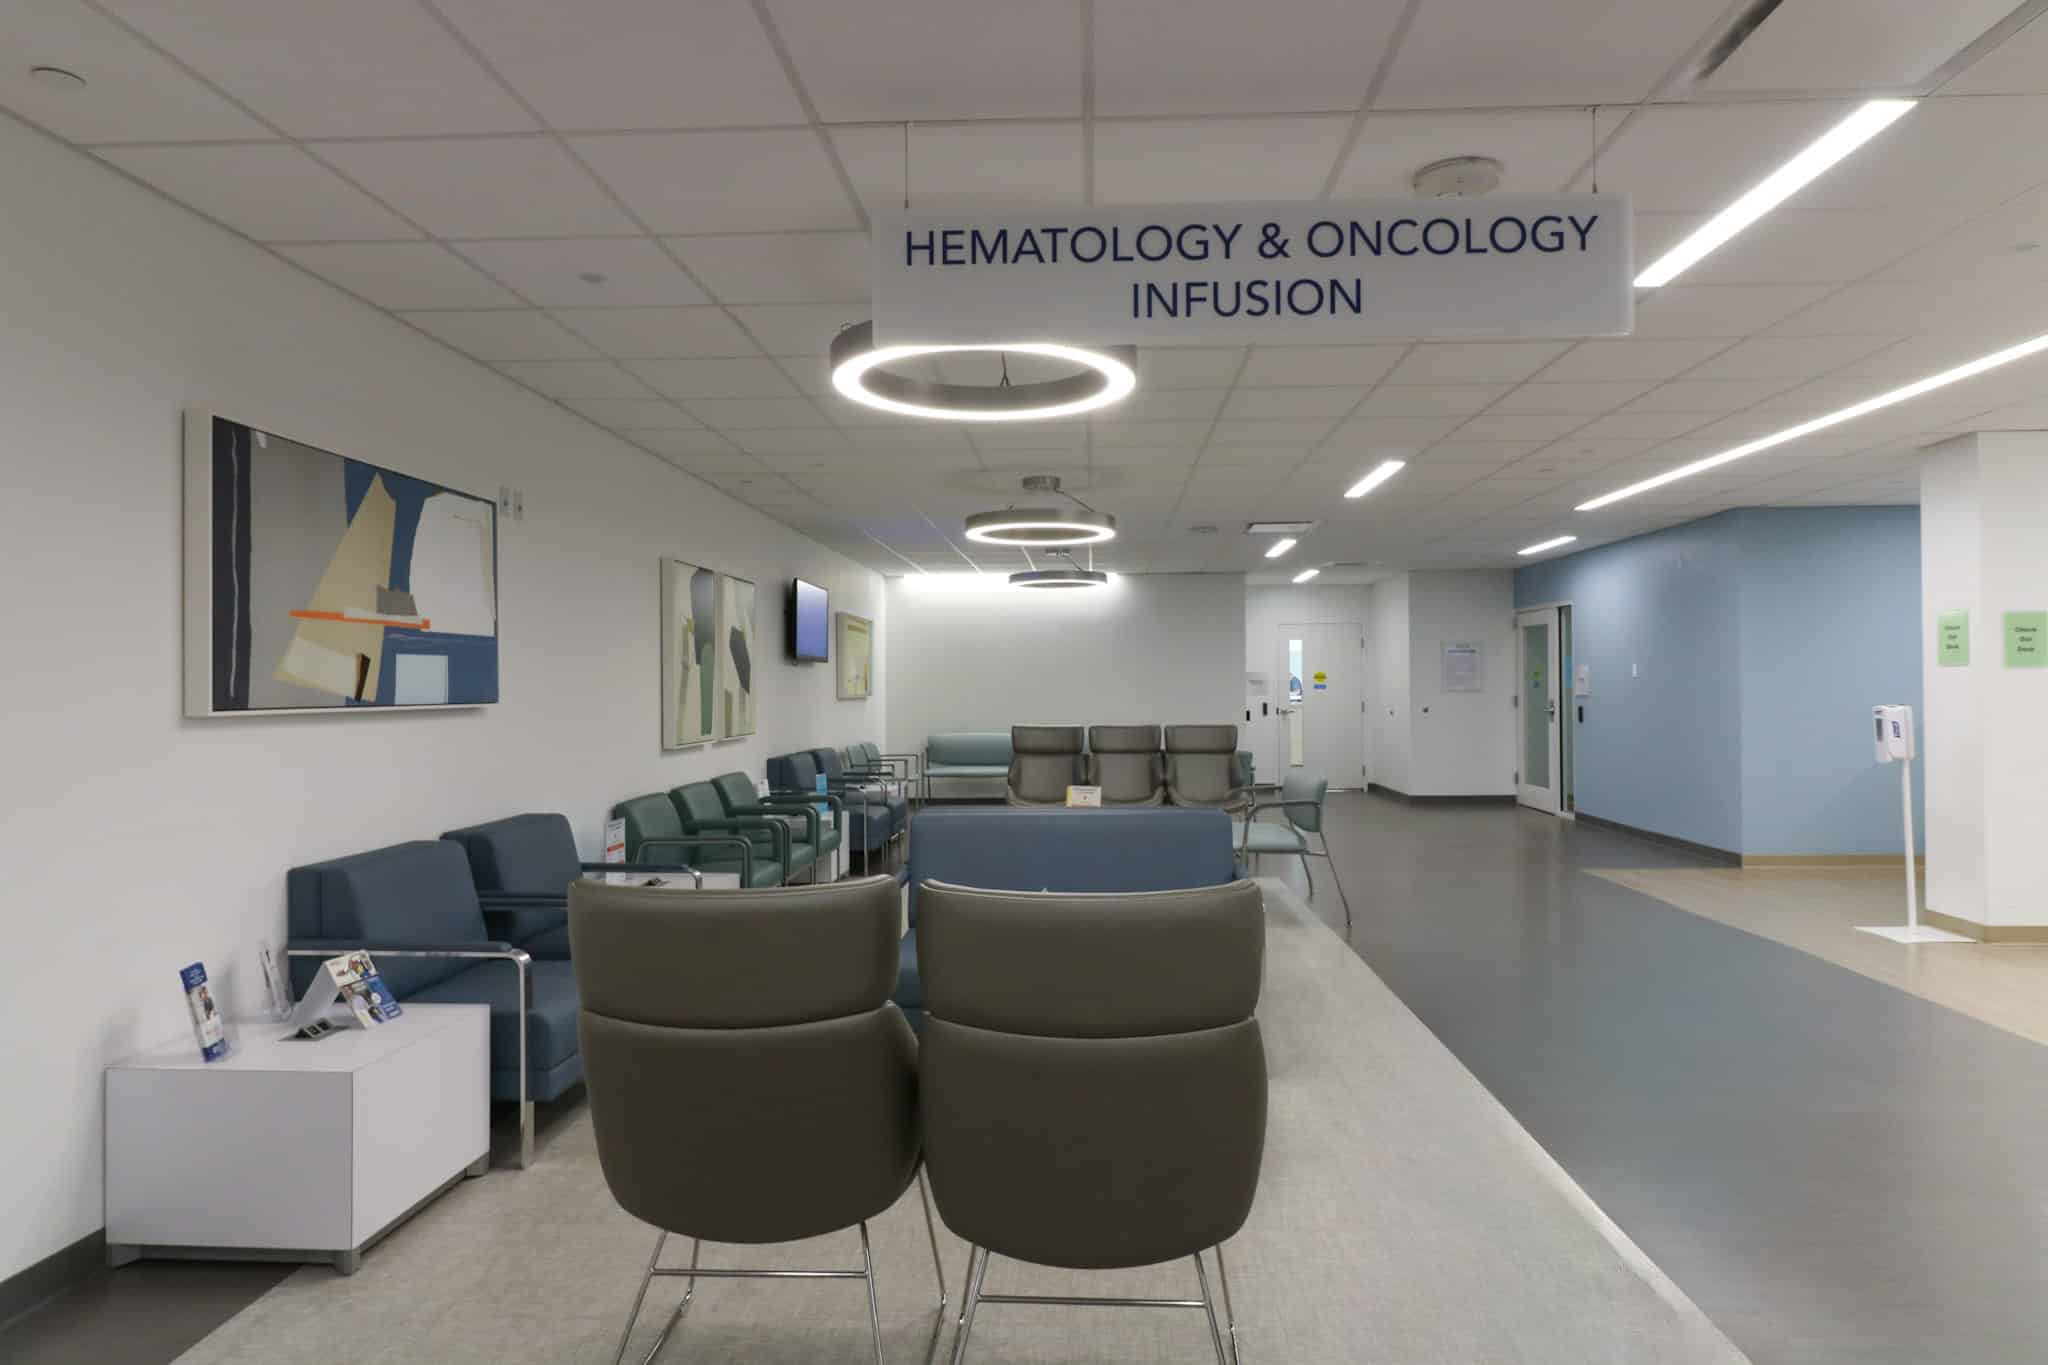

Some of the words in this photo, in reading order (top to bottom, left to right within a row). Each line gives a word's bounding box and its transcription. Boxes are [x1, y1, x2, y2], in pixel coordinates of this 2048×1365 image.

[906, 223, 1243, 267] HEMATOLOGY
[1257, 222, 1291, 259] &
[1306, 215, 1599, 258] ONCOLOGY
[1133, 278, 1363, 318] INFUSION
